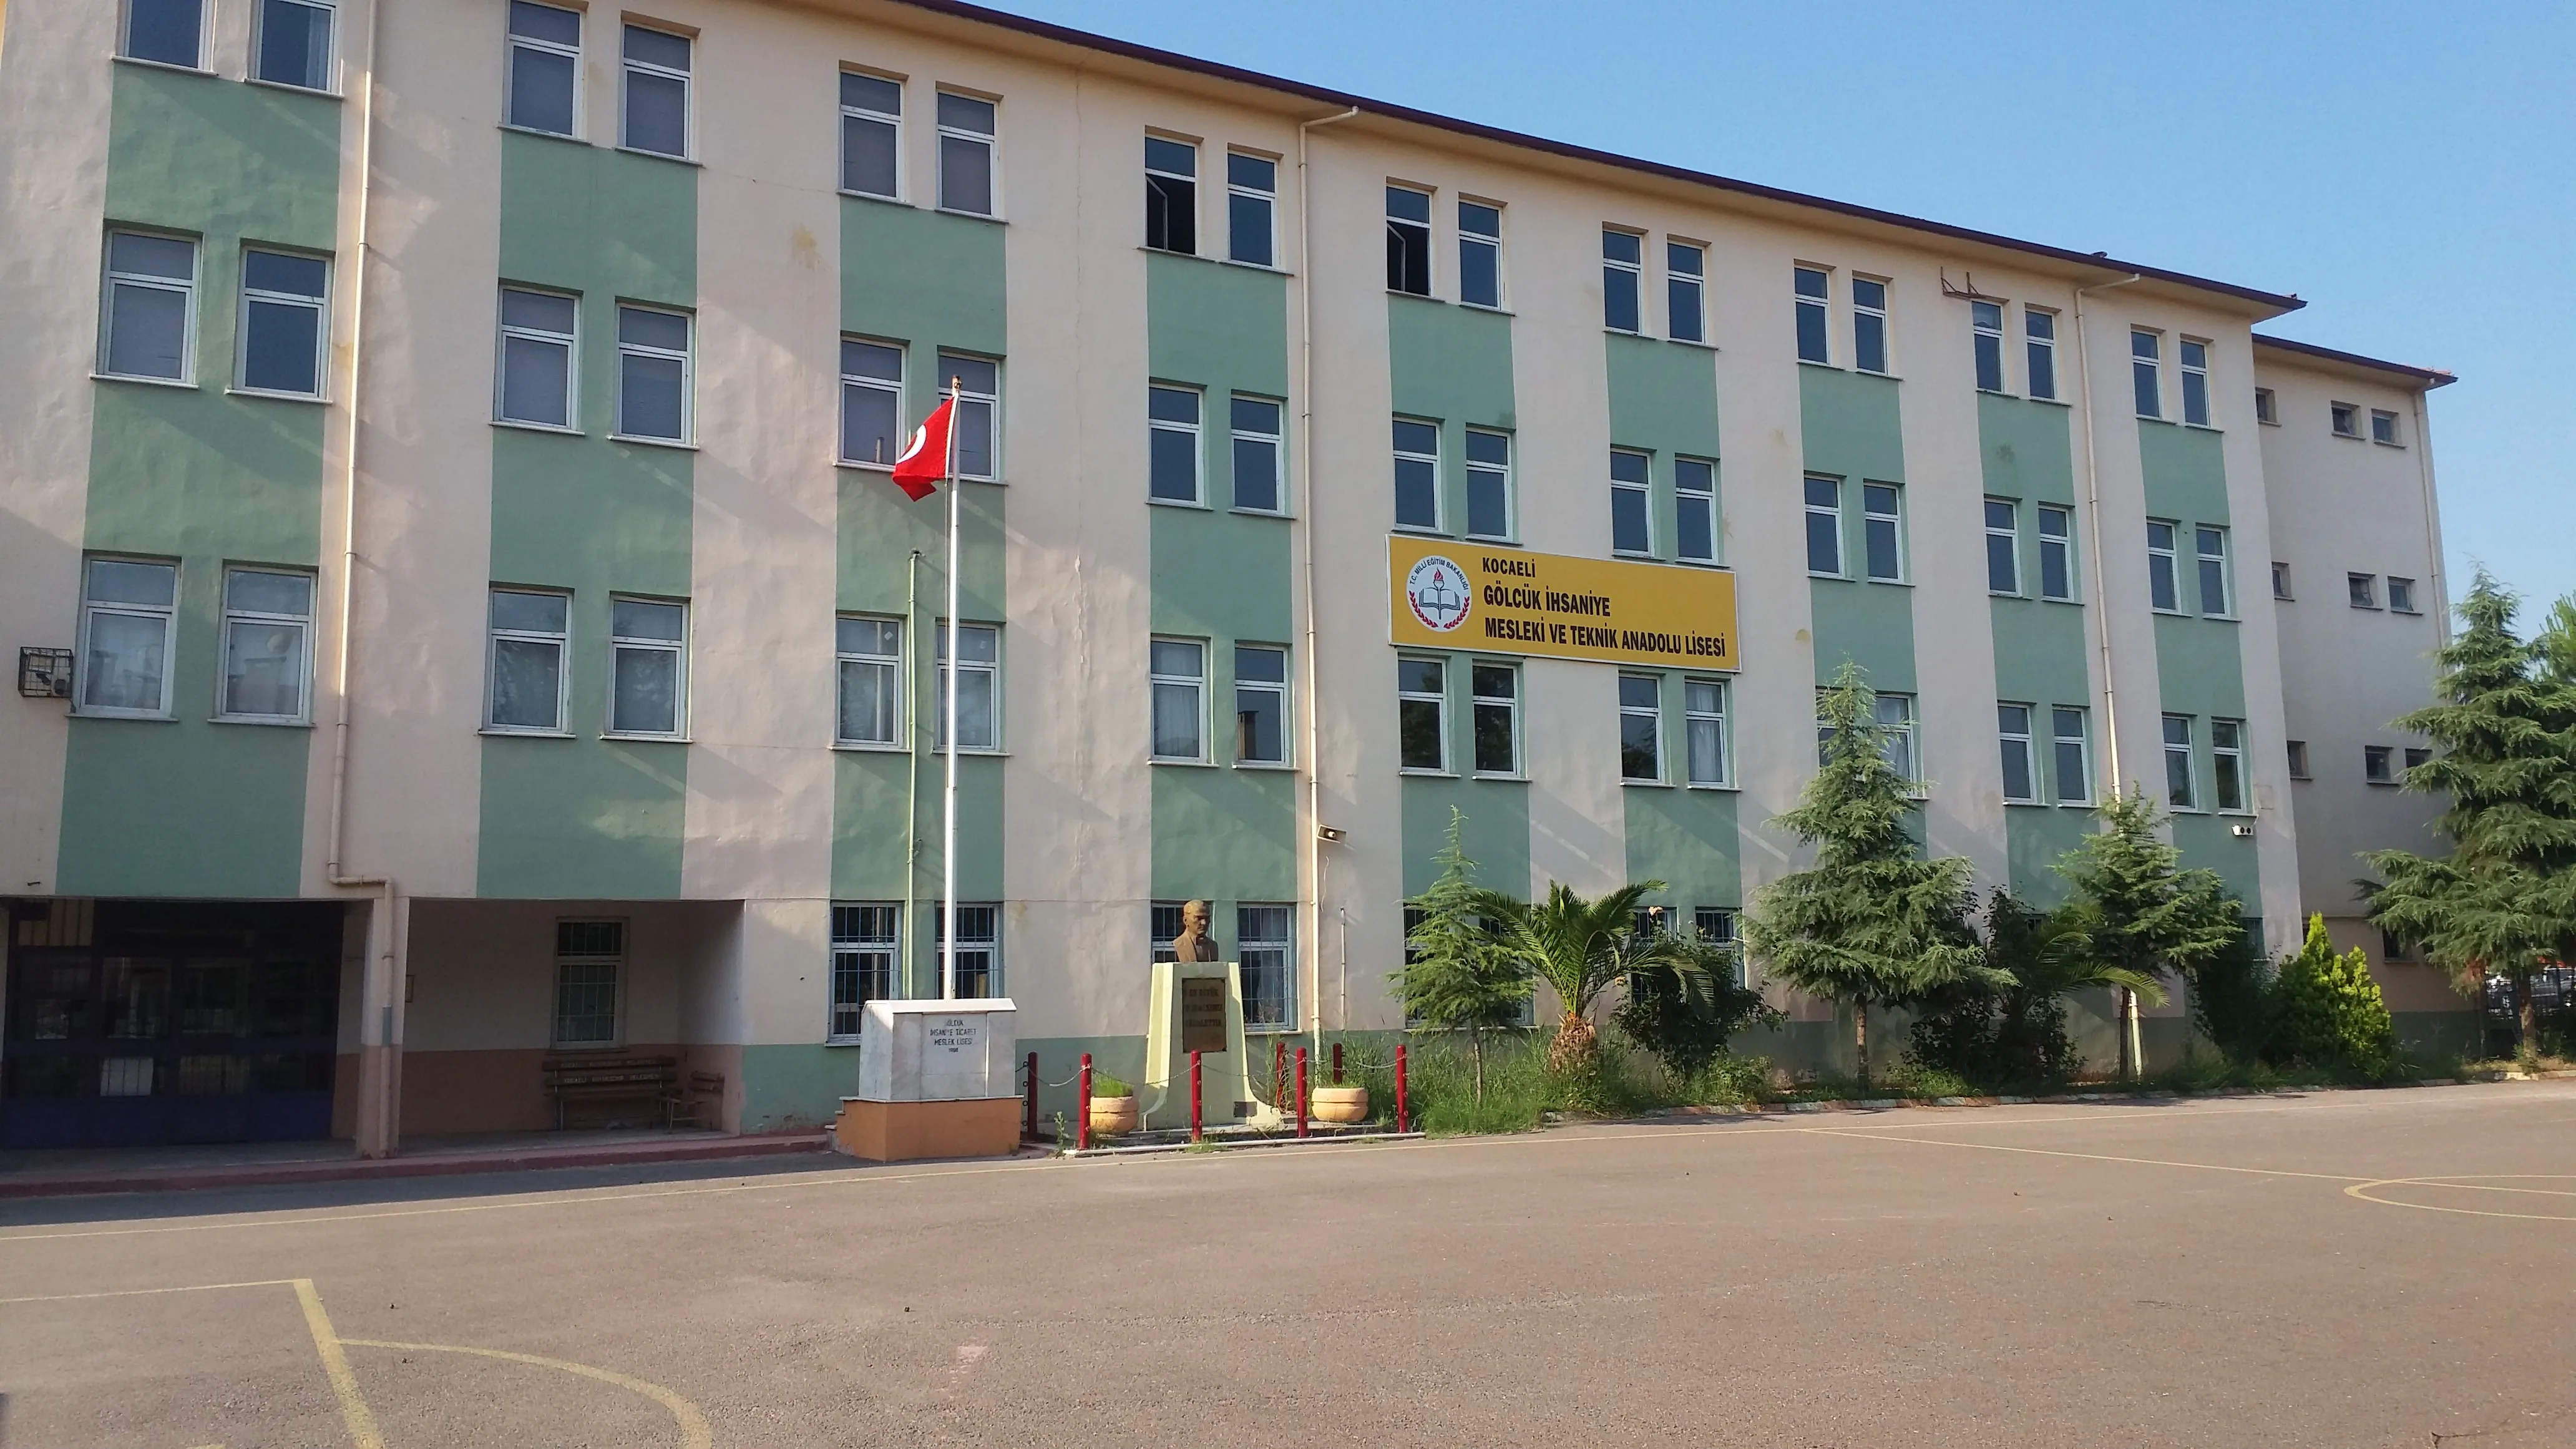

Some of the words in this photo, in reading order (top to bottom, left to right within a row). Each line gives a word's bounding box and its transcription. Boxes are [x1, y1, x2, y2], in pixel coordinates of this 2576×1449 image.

[1427, 557, 1445, 566] EĞİTİM
[1446, 562, 1469, 590] BAKANLIĞI
[1482, 557, 1536, 578] KOCAELİ
[1483, 580, 1542, 610] GÖLCÜK
[1546, 585, 1611, 617] İHSANİYE
[1485, 616, 1545, 643] MESLEKİ
[1549, 623, 1567, 644] VE
[1570, 622, 1618, 649] TEKNİK
[1622, 630, 1681, 654] ANADOLU
[1685, 630, 1725, 657] LİSESİ
